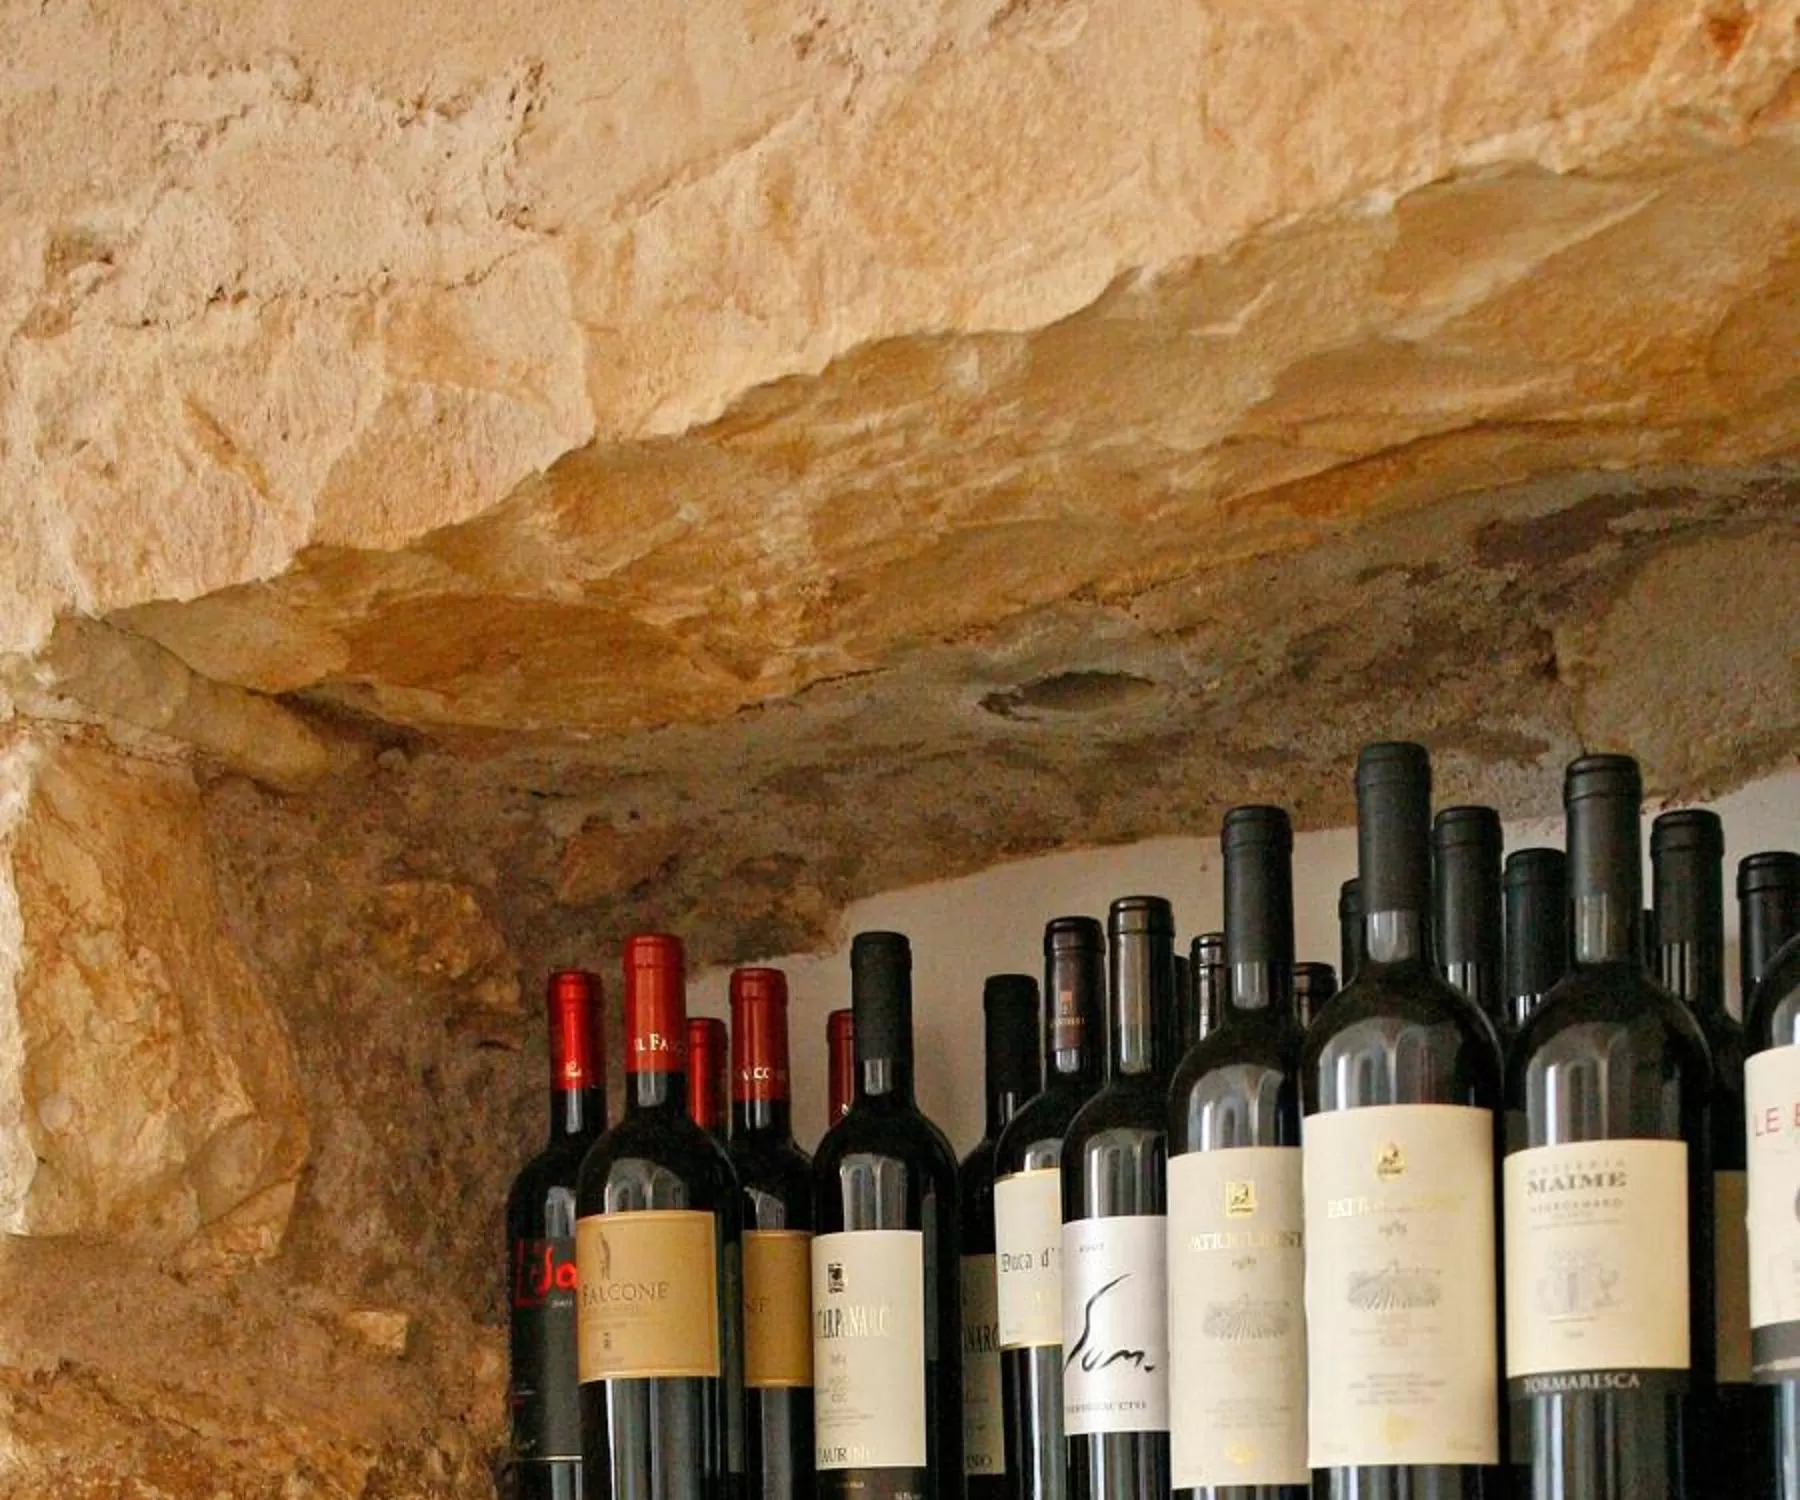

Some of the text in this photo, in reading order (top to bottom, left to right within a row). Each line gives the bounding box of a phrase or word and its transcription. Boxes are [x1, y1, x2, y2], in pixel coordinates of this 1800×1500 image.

[1755, 1107, 1779, 1136] LE
[1528, 1171, 1628, 1194] MAIME
[1523, 1372, 1642, 1393] TORMARESCA
